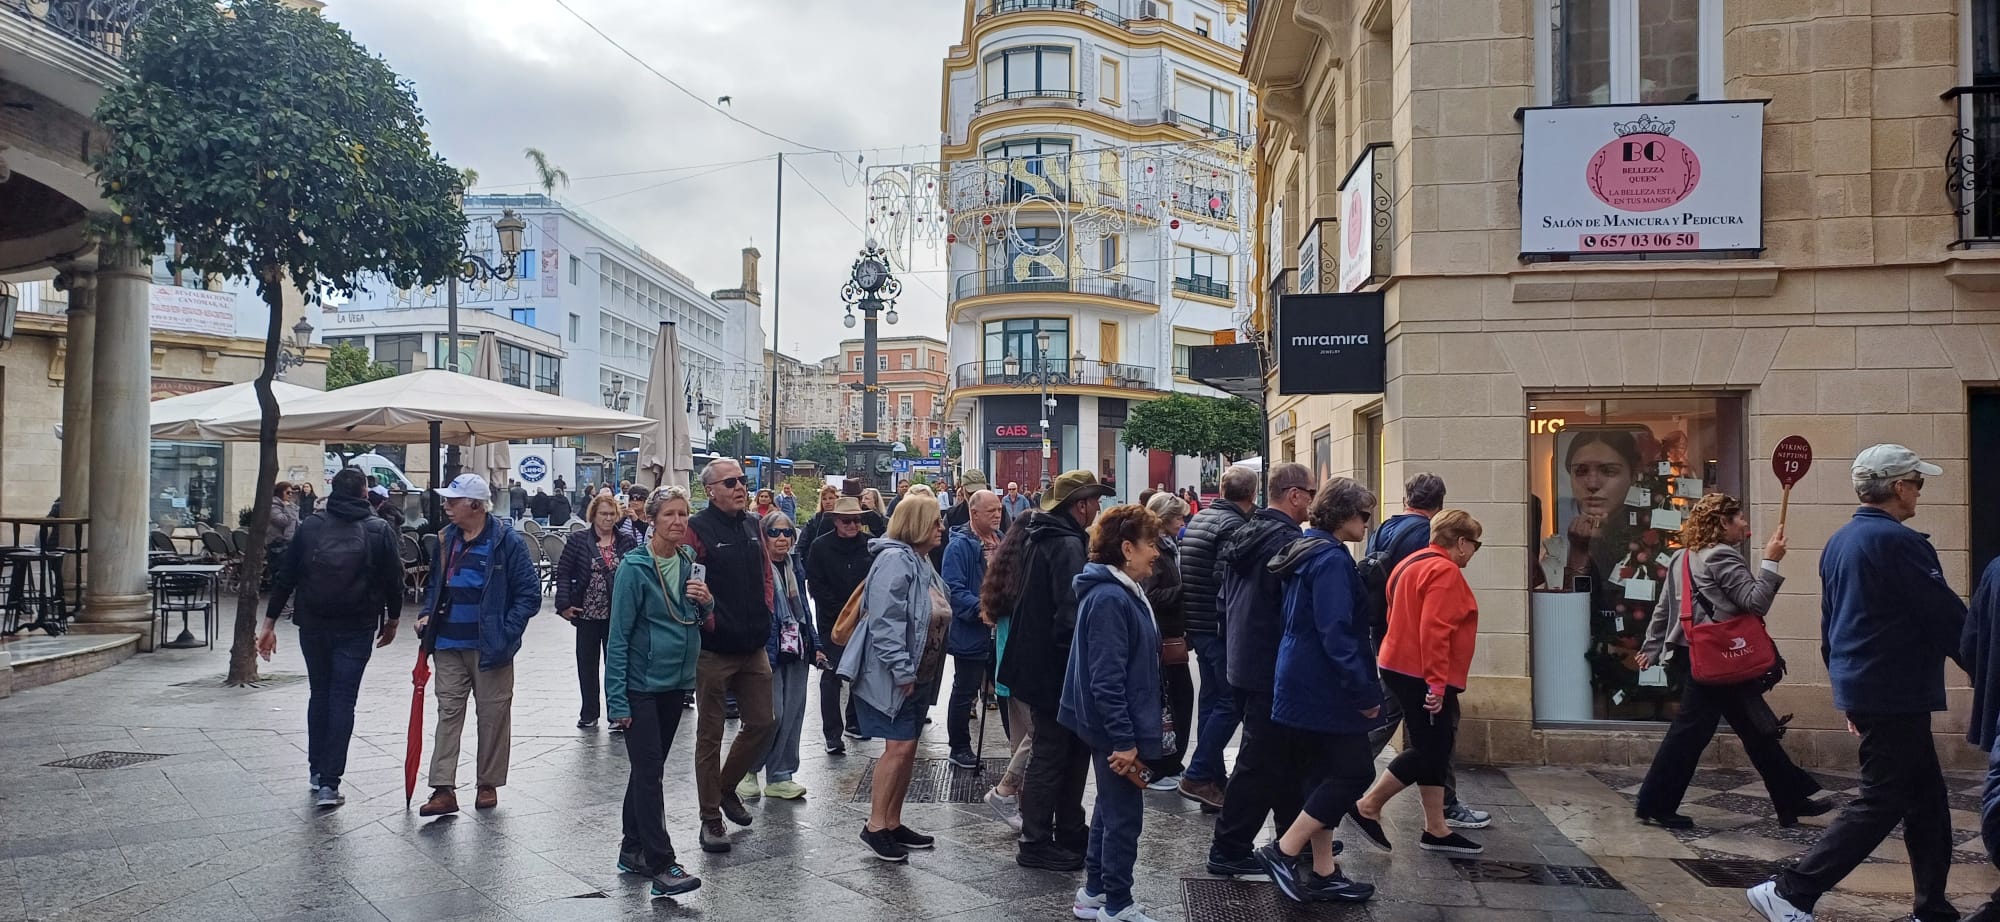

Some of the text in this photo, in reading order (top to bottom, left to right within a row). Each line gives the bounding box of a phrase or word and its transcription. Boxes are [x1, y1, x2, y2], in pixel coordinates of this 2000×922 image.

[1623, 140, 1666, 163] BQ
[1657, 187, 1676, 195] ESTÁ
[1672, 218, 1680, 226] Y
[1600, 233, 1694, 248] 657 03 06 50
[337, 312, 365, 323] LA VEGA
[1292, 335, 1369, 346] miramira
[995, 425, 1028, 436] GAES
[933, 439, 941, 449] P
[1780, 443, 1808, 452] VIKING
[1784, 460, 1799, 473] 19
[1721, 646, 1754, 658] VIKING
